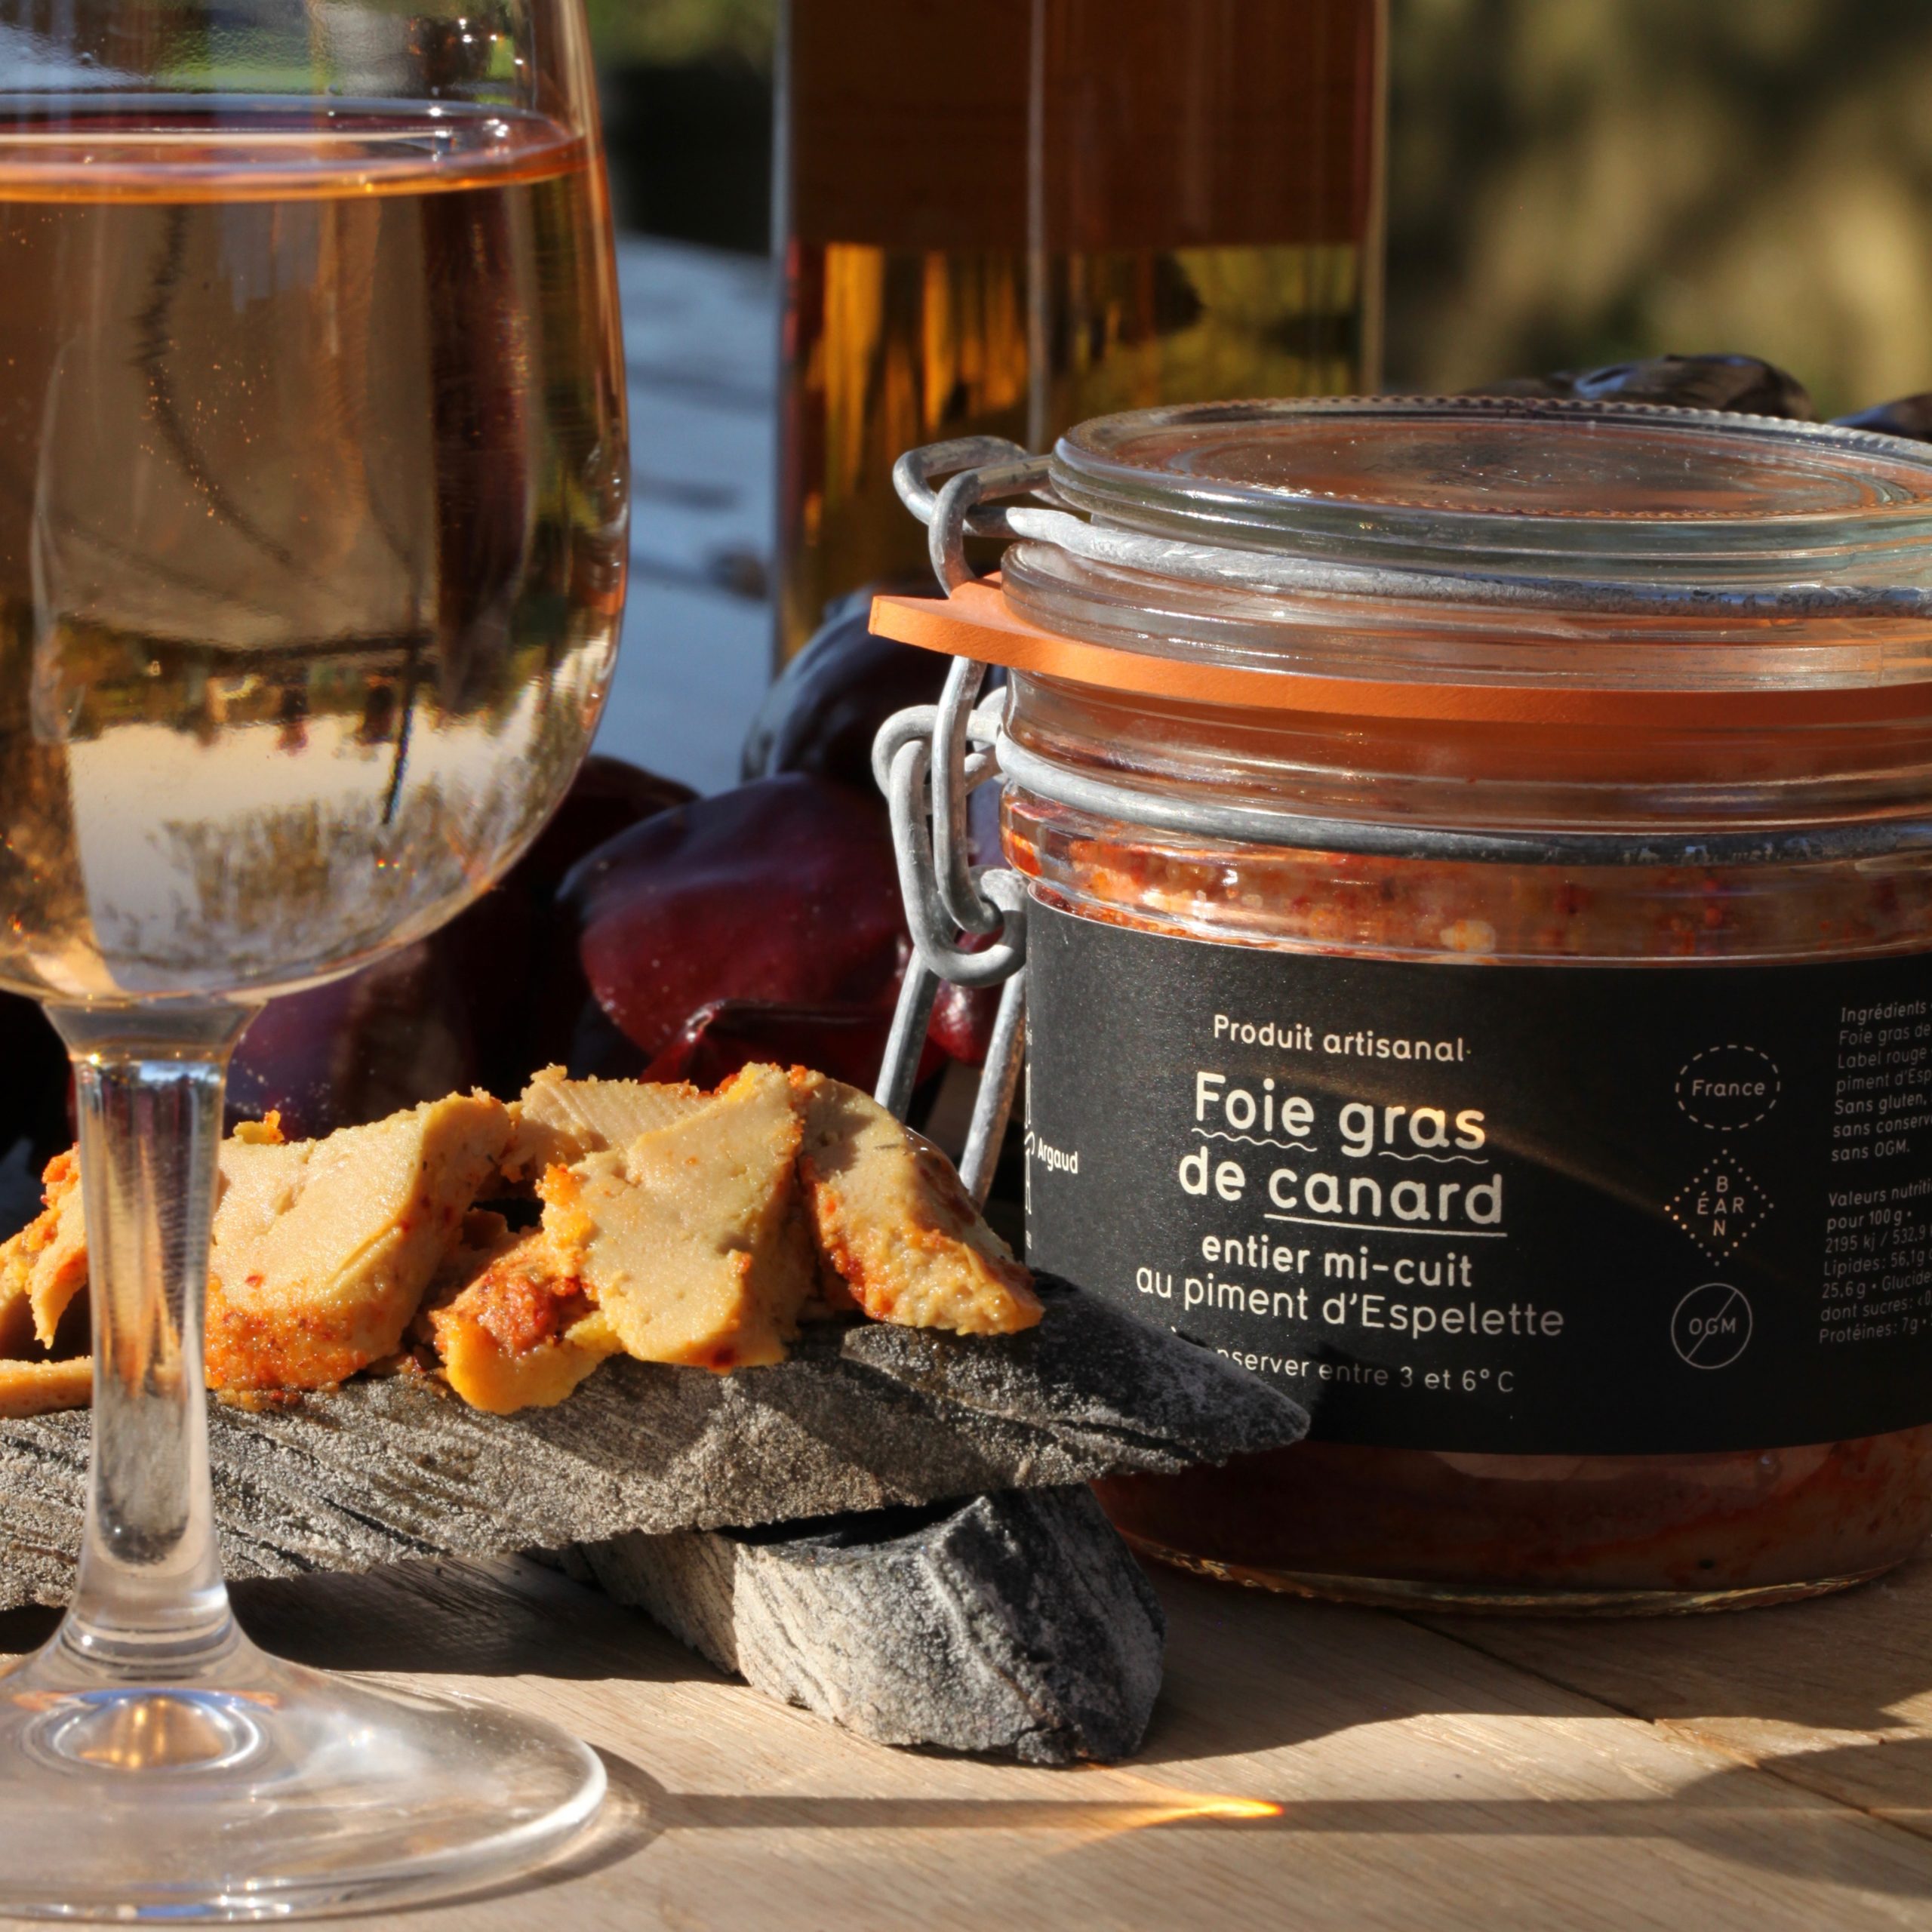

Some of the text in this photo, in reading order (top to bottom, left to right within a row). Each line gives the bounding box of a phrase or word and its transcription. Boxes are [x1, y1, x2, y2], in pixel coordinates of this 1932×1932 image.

[1841, 1000, 1926, 1026] Ingrédients
[1214, 1015, 1464, 1062] Produit artisanal
[1839, 1023, 1931, 1046] Foie gras de
[1838, 1048, 1927, 1069] Label rouge
[1692, 1080, 1765, 1097] France
[1837, 1072, 1890, 1095] piment
[1195, 1072, 1486, 1158] Foie gras
[1835, 1099, 1872, 1115] Sans
[1833, 1115, 1932, 1138] sans conserv
[1038, 1137, 1078, 1174] Argaud
[1832, 1140, 1909, 1161] sans OGM.
[1179, 1146, 1503, 1224] de canard
[1829, 1179, 1932, 1207] Valeurs nutriti
[1827, 1215, 1864, 1233] pour
[1825, 1235, 1858, 1254] 2195
[1202, 1235, 1472, 1287] entier mi-cuit
[1824, 1258, 1886, 1278] Lipides:
[1136, 1266, 1565, 1339] au piment d'Espelette
[1820, 1303, 1857, 1321] dont
[1863, 1297, 1912, 1317] sucres:
[1689, 1317, 1737, 1335] OGM
[1820, 1323, 1897, 1343] Protéines:
[1318, 1363, 1389, 1386] entre
[1400, 1367, 1413, 1388] 3
[1424, 1371, 1451, 1390] et
